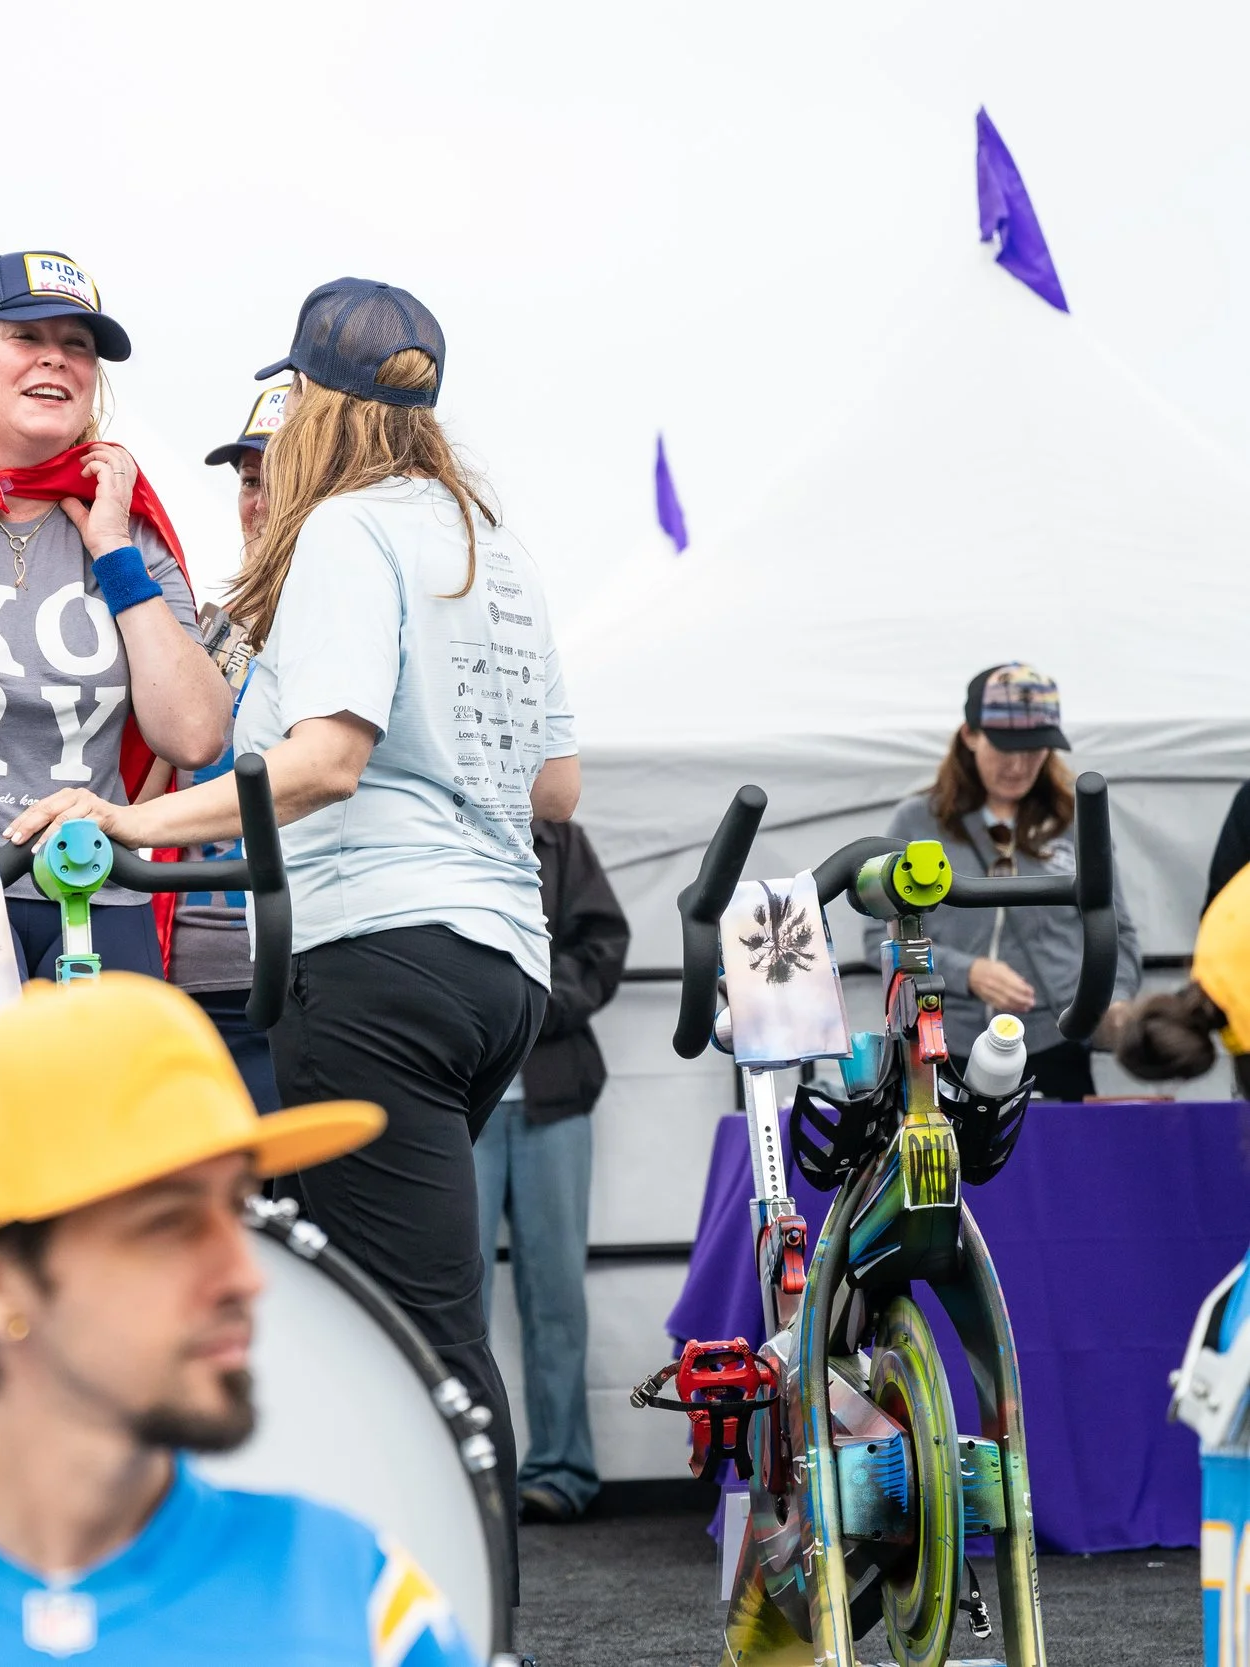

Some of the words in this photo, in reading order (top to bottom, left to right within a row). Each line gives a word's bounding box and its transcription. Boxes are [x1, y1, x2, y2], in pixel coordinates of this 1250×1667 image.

[40, 260, 86, 285] RIDE
[58, 275, 76, 286] ON
[255, 416, 280, 429] KO
